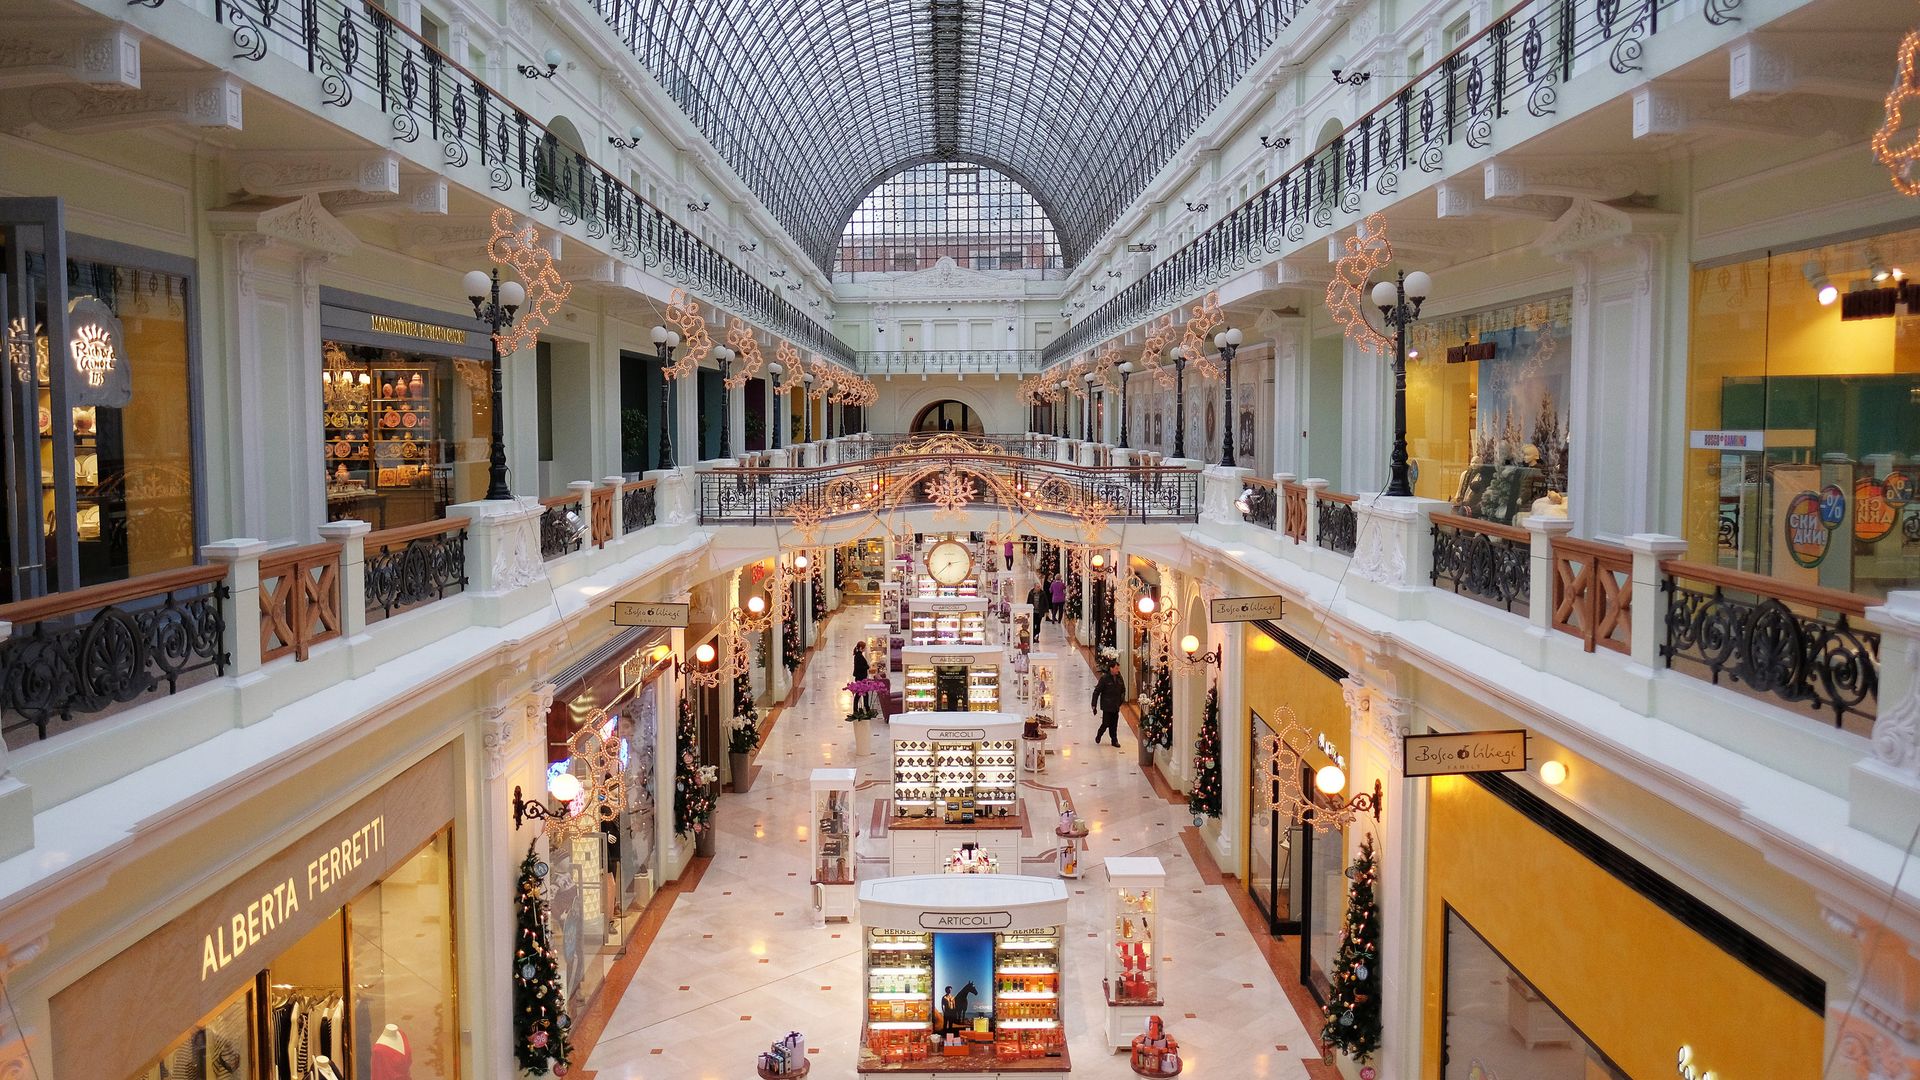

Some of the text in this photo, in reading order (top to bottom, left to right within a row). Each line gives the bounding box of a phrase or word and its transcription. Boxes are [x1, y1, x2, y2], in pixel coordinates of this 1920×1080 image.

[1789, 513, 1818, 530] СКИ
[1415, 745, 1454, 765] Bosco
[201, 814, 385, 983] ALBERTA FERRETTI
[938, 916, 992, 926] ARTICOLI
